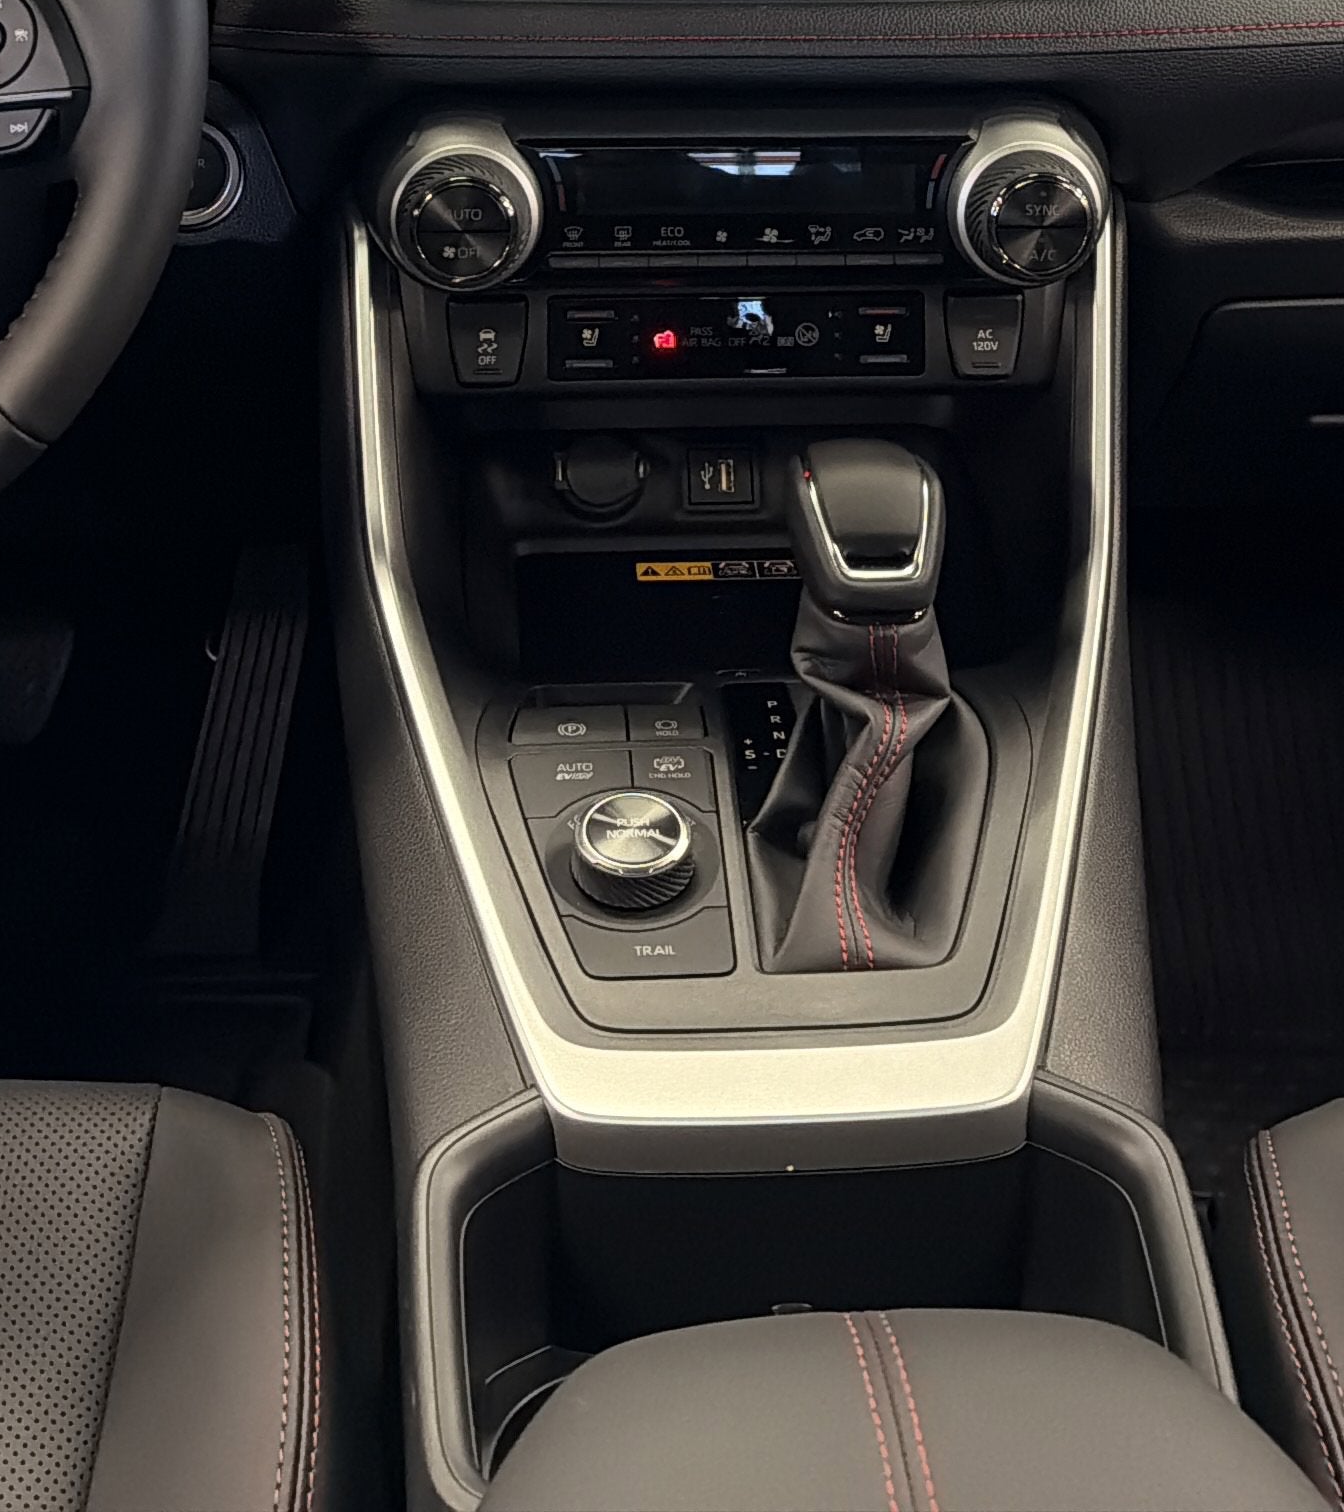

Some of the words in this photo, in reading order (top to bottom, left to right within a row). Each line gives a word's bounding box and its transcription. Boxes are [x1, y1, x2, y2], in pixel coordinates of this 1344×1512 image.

[447, 208, 482, 221] AUTO
[1024, 204, 1061, 216] SYNC
[660, 226, 684, 237] ECO
[457, 248, 481, 259] OFF
[1030, 249, 1056, 261] A/C
[690, 326, 713, 336] PASS
[977, 328, 994, 339] AC
[701, 337, 722, 347] BAG
[972, 341, 999, 351] 120V
[478, 355, 497, 365] OFF
[767, 700, 778, 709] P
[769, 715, 783, 724] R
[772, 730, 786, 740] N
[744, 749, 757, 760] S
[556, 763, 593, 772] AUTO
[616, 818, 650, 827] PUSH
[606, 828, 663, 839] NORMAL
[633, 944, 677, 957] TRAIL
